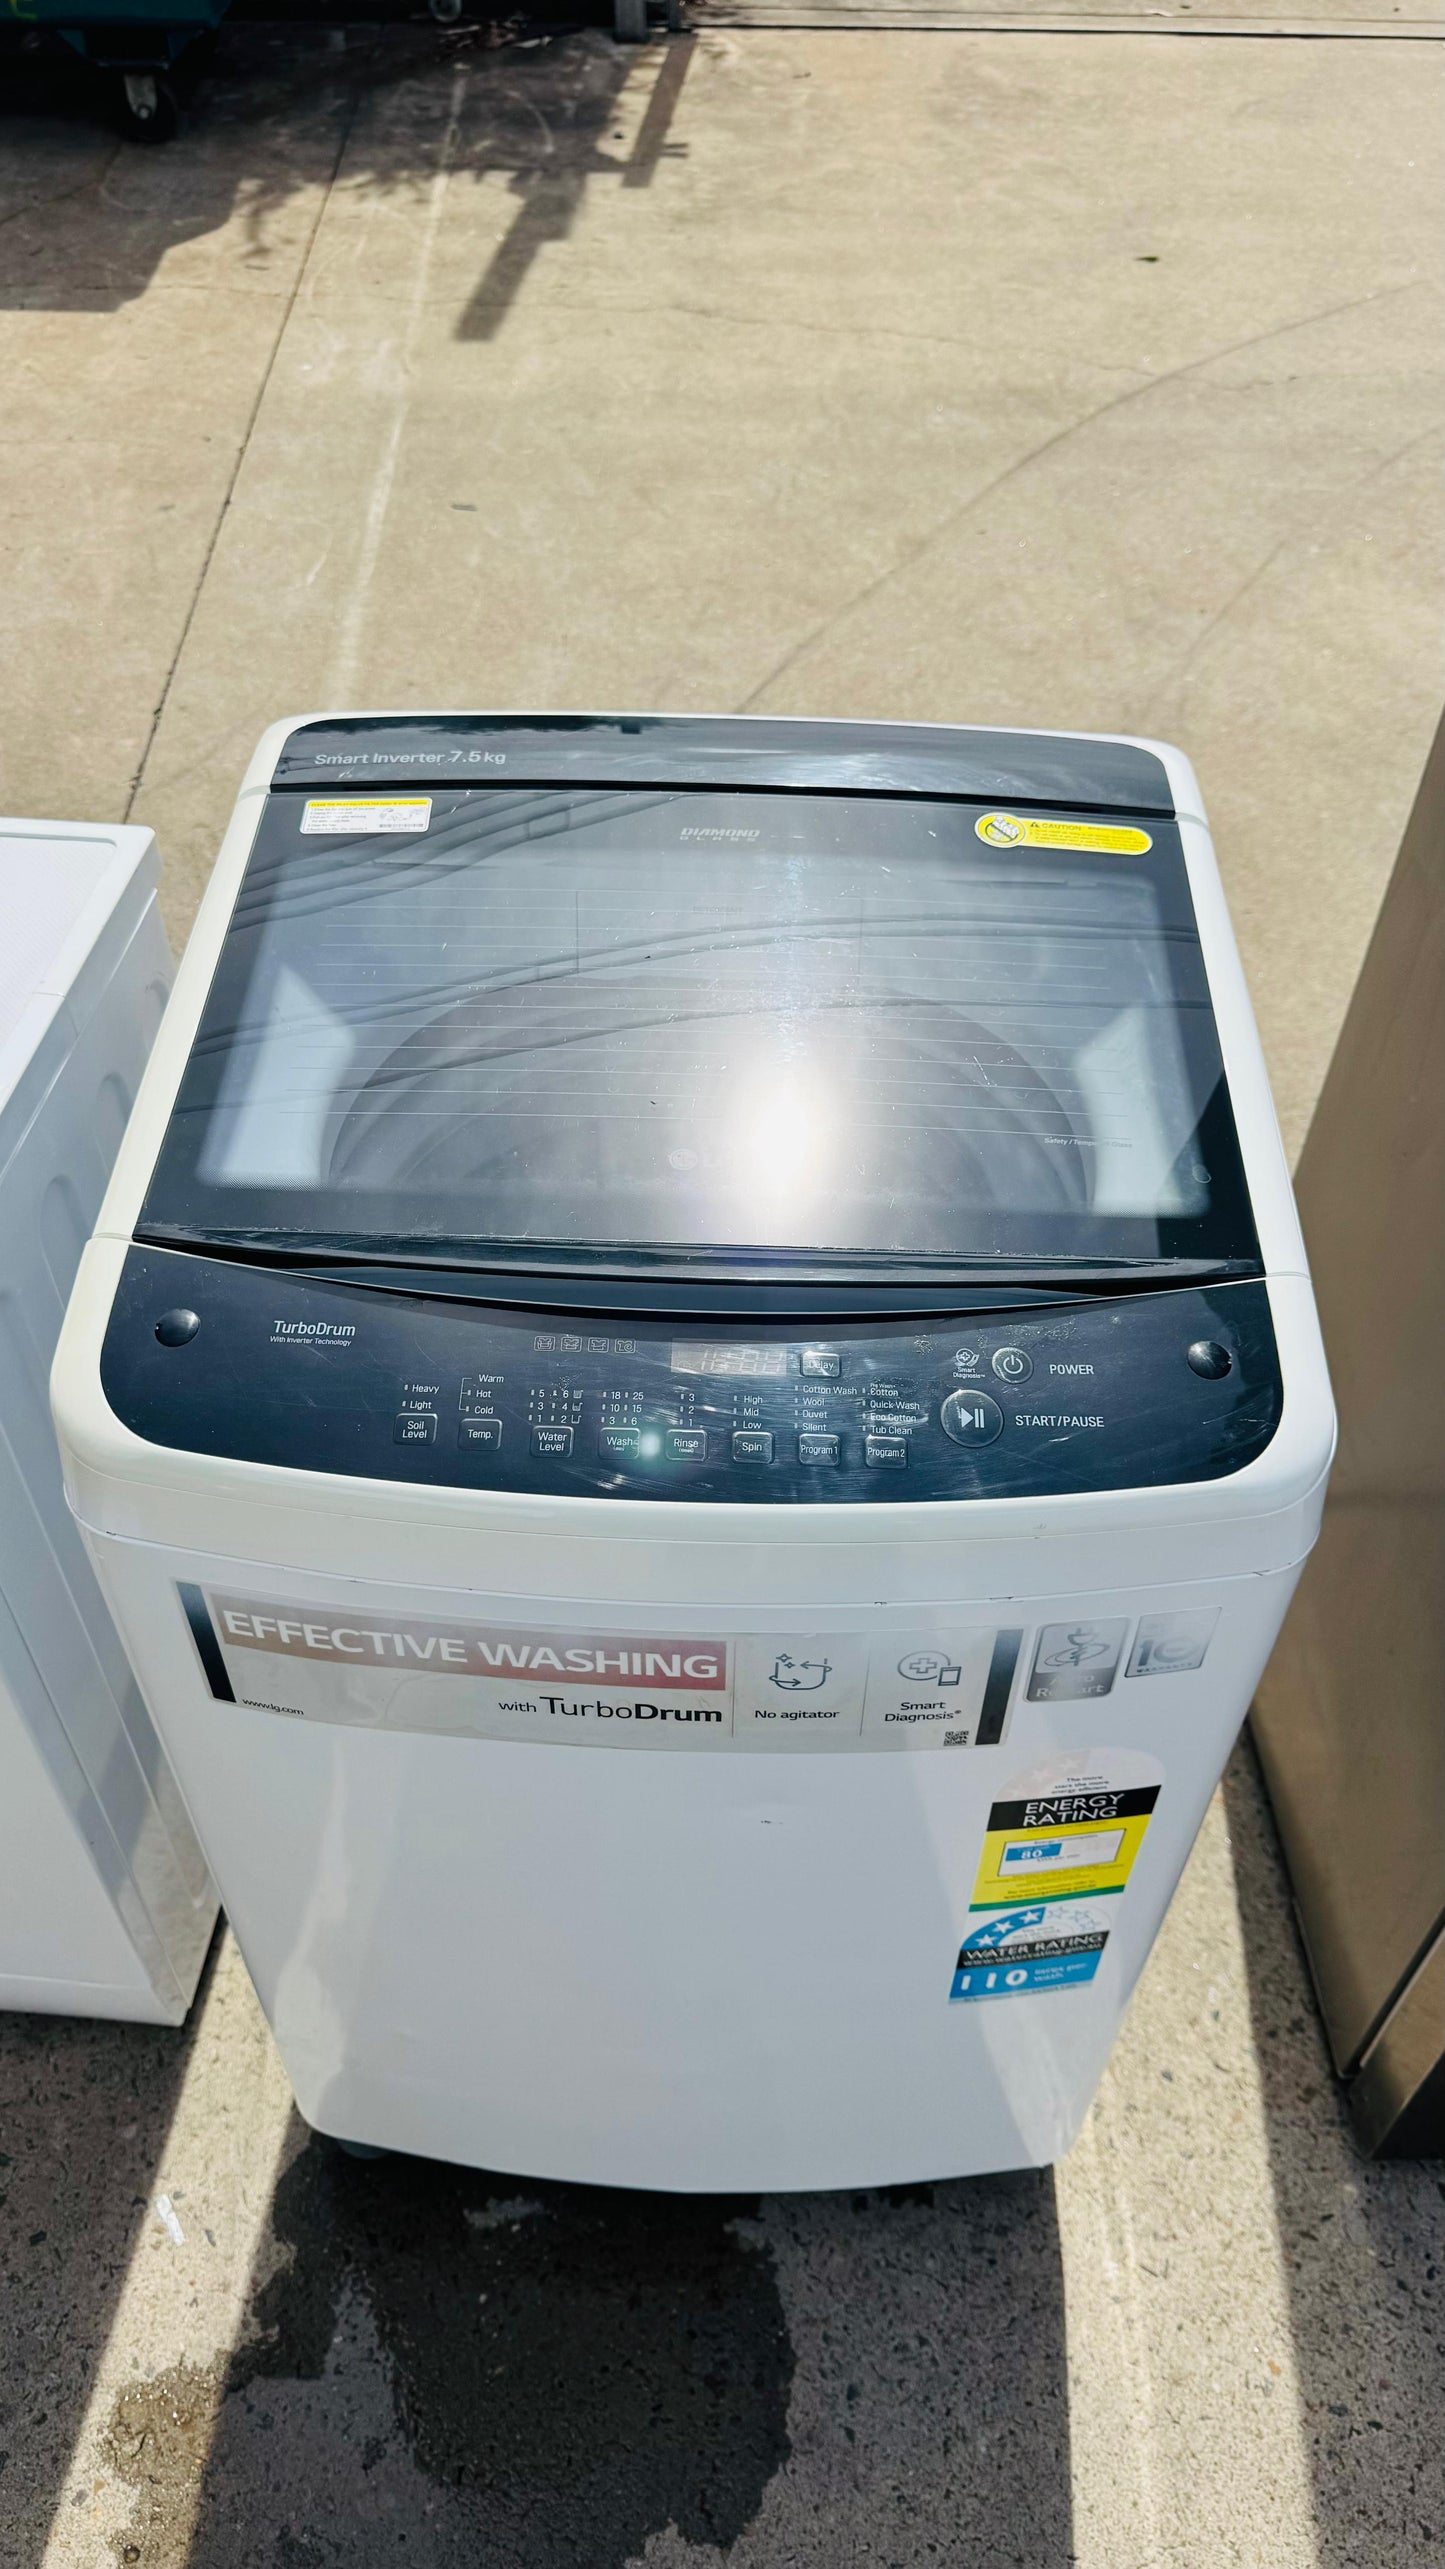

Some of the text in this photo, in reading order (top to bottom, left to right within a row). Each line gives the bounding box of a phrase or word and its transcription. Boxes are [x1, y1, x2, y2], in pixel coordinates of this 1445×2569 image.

[314, 753, 368, 765] Smart
[373, 752, 446, 764] Inverter
[680, 827, 761, 837] DIAMOND
[1041, 822, 1082, 832] CAUTION
[273, 1320, 356, 1337] TurboDrum
[270, 1335, 352, 1347] With Inverter Technology
[957, 1366, 976, 1374] Smart
[1049, 1364, 1095, 1375] POWER
[478, 1374, 505, 1384] Warm
[412, 1384, 440, 1395] Heavy
[476, 1389, 492, 1398] Hot
[538, 1389, 570, 1399] 5 6
[802, 1385, 858, 1395] Cotton Wash
[870, 1388, 899, 1397] Cotton
[610, 1391, 644, 1400] 18 25
[688, 1393, 695, 1402] 3
[743, 1395, 763, 1405] High
[409, 1400, 432, 1410] Light
[537, 1402, 569, 1411] 3 4
[803, 1398, 825, 1406] Wool
[870, 1399, 920, 1410] Quick Wash
[474, 1405, 494, 1415] Cold
[609, 1404, 642, 1413] 10 15
[688, 1406, 695, 1414] 2
[743, 1408, 759, 1416] Mid
[560, 1415, 568, 1424] 2
[802, 1410, 828, 1419] Duvet
[870, 1412, 917, 1422] Eco Cotton
[407, 1420, 425, 1431] Soil
[609, 1416, 638, 1426] 3 6
[742, 1420, 762, 1429] Low
[1015, 1415, 1105, 1428] START/PAUSE
[802, 1422, 827, 1432] Silent
[871, 1425, 913, 1435] Tub Clean
[402, 1429, 428, 1439] Level
[467, 1429, 494, 1440] Temp.
[537, 1431, 568, 1442] Water
[606, 1436, 633, 1446] Wash
[673, 1438, 699, 1448] Rinse
[539, 1441, 565, 1452] Level
[741, 1442, 763, 1452] Spin
[800, 1445, 833, 1455] Program
[867, 1447, 899, 1458] Program
[222, 1608, 719, 1680] EFFECTIVE WASHING
[242, 1696, 304, 1716] www.lg.com
[498, 1696, 723, 1723] with TurboDrum
[899, 1701, 947, 1711] Smart
[754, 1709, 840, 1721] No agitator
[1025, 1793, 1125, 1815] ENERGY
[1022, 1806, 1119, 1827] RATING
[1020, 1848, 1043, 1860] 80
[965, 1945, 1029, 1960] WATER
[1034, 1933, 1104, 1949] RATING
